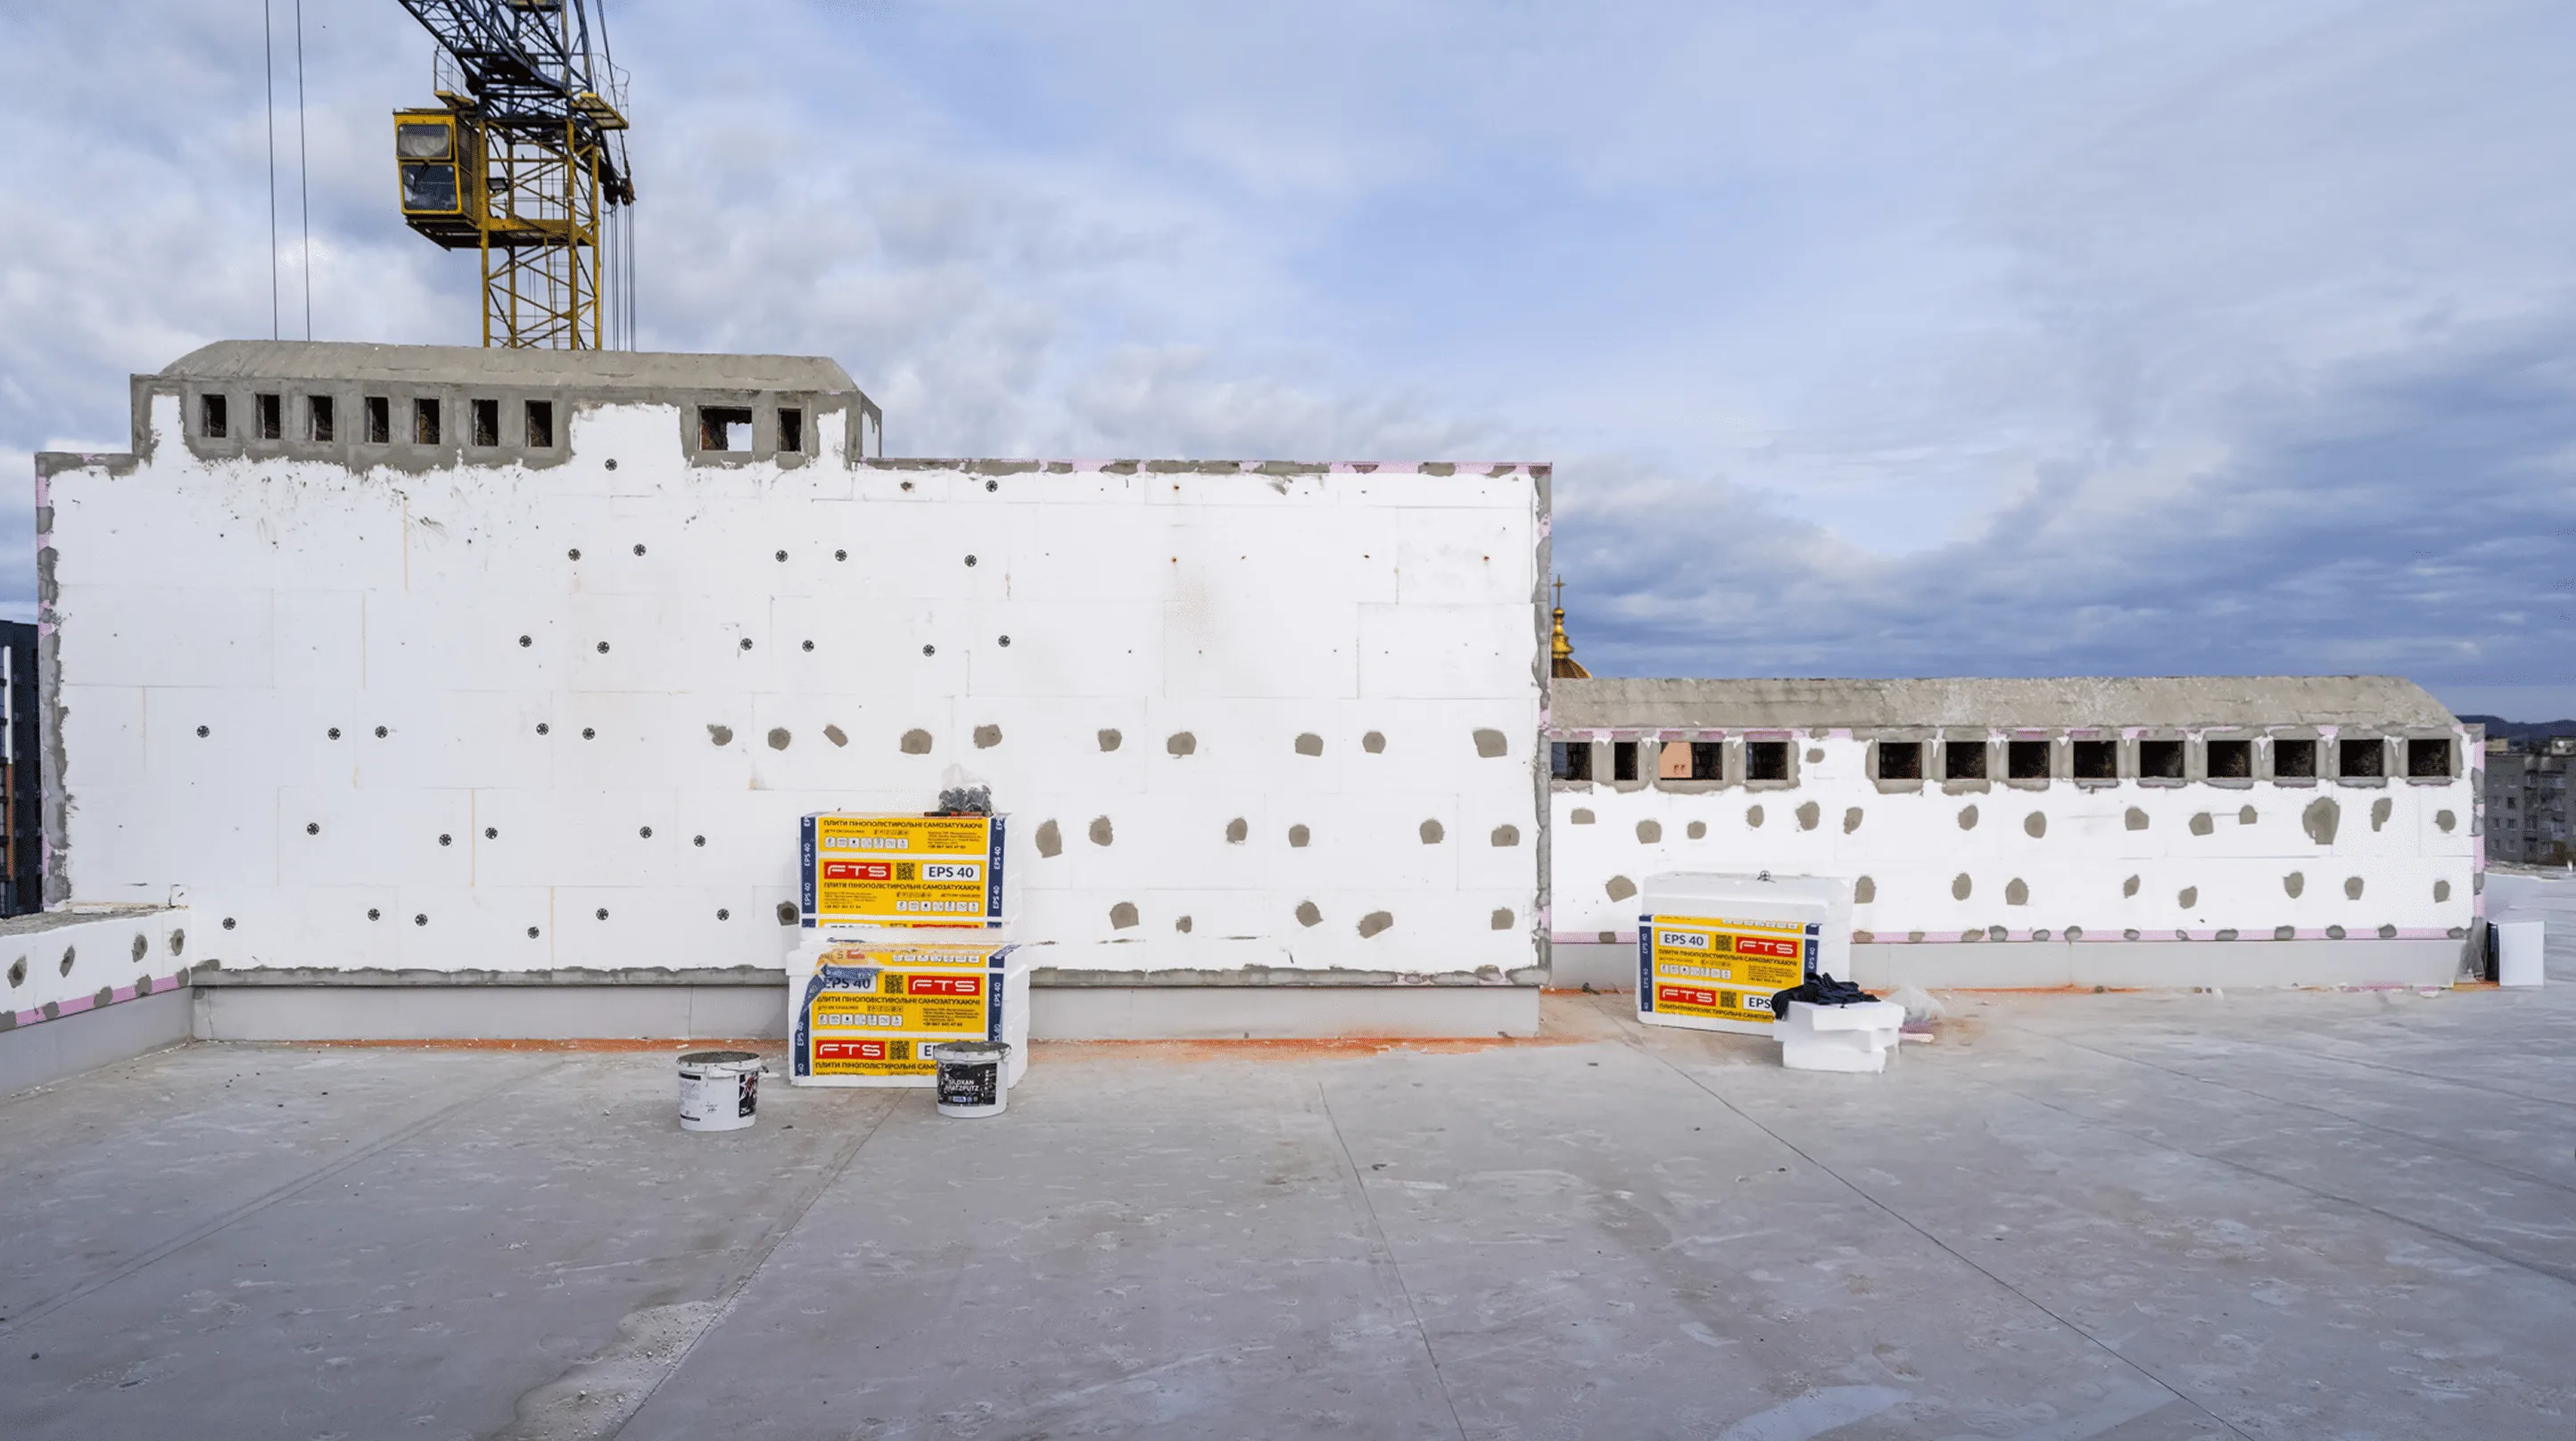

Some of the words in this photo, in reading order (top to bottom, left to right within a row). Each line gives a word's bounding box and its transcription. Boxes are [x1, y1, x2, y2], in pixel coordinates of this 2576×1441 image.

[995, 845, 1002, 855] 40
[827, 864, 888, 877] FTS
[929, 866, 954, 878] EPS
[956, 867, 974, 878] 40
[804, 882, 811, 892] 40
[993, 885, 1000, 895] 40
[804, 893, 812, 906] EPS
[992, 895, 1000, 909] EPS
[1664, 934, 1687, 945] EPS
[1688, 936, 1705, 946] 40
[1739, 940, 1794, 954] FTS
[1809, 947, 1815, 956] 40
[912, 979, 976, 992] FTS
[994, 982, 1001, 992] 40
[1662, 988, 1713, 1003] FTS
[1748, 997, 1771, 1009] EPS
[820, 1043, 881, 1057] FTS
[814, 1061, 841, 1069] ПЛИТИ
